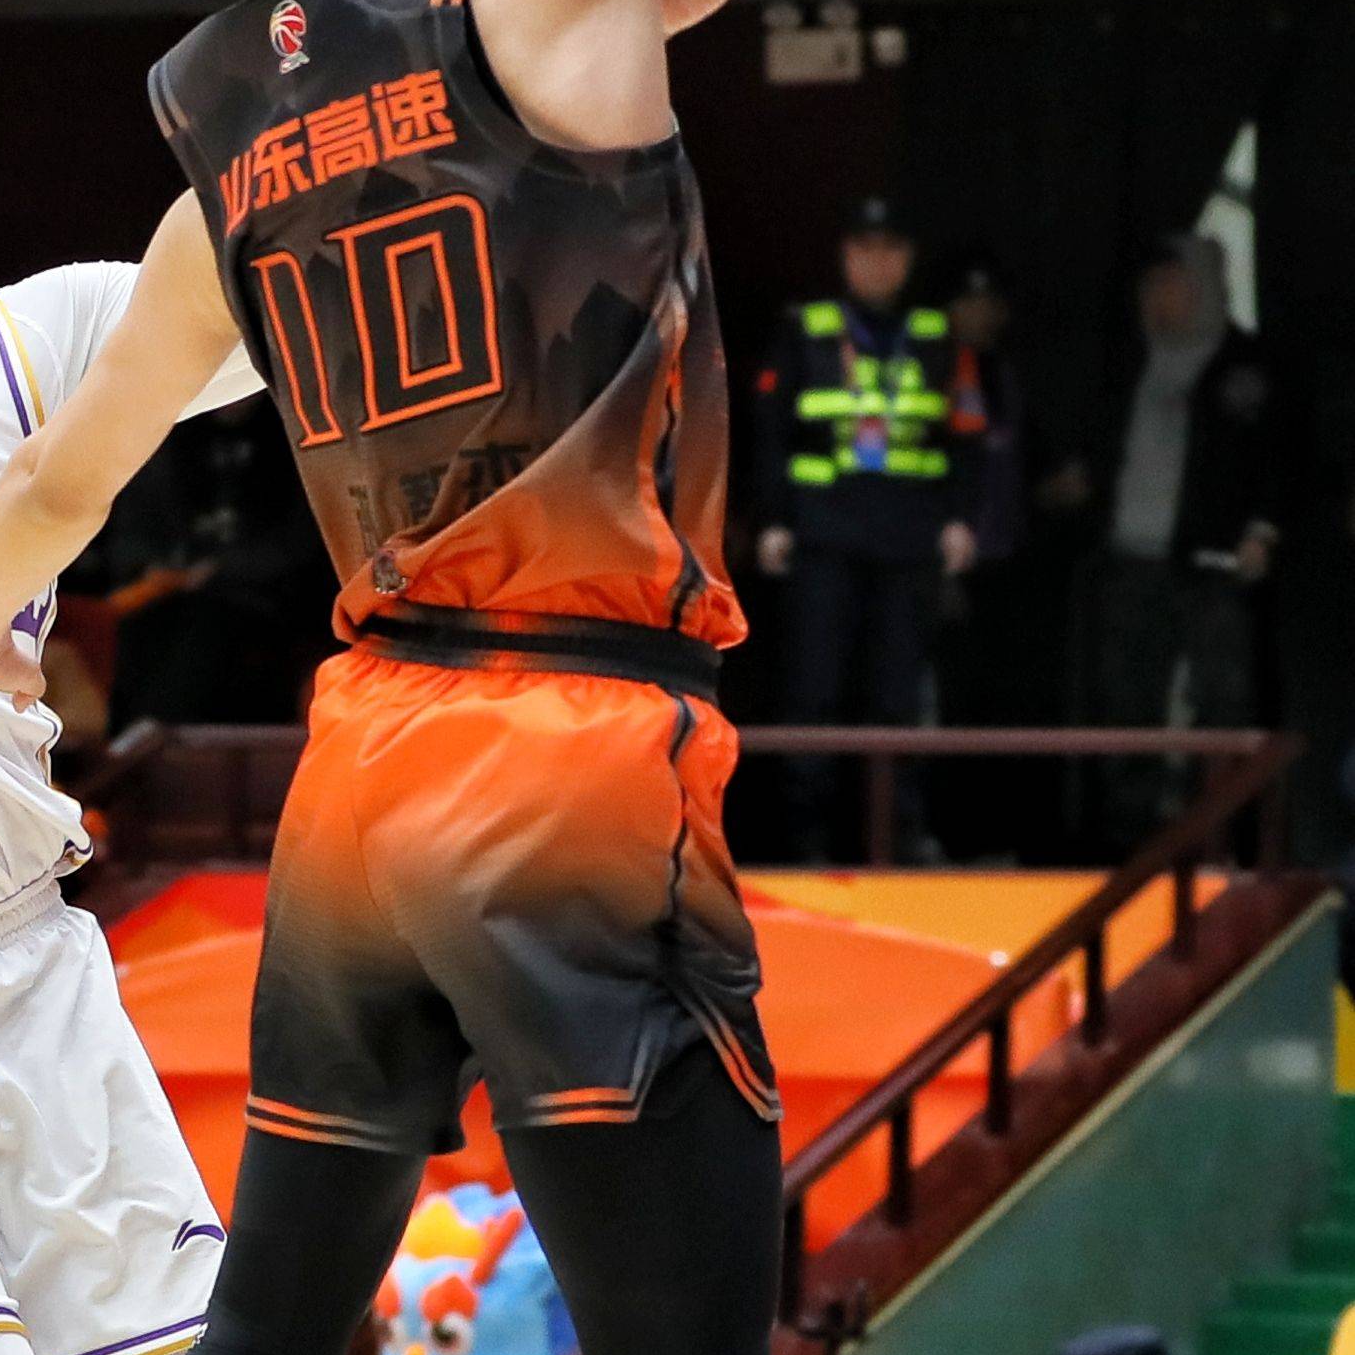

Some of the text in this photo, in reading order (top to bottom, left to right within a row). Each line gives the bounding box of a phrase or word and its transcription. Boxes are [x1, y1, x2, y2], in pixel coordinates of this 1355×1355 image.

[219, 68, 458, 239] 山东高速
[249, 193, 504, 449] 10
